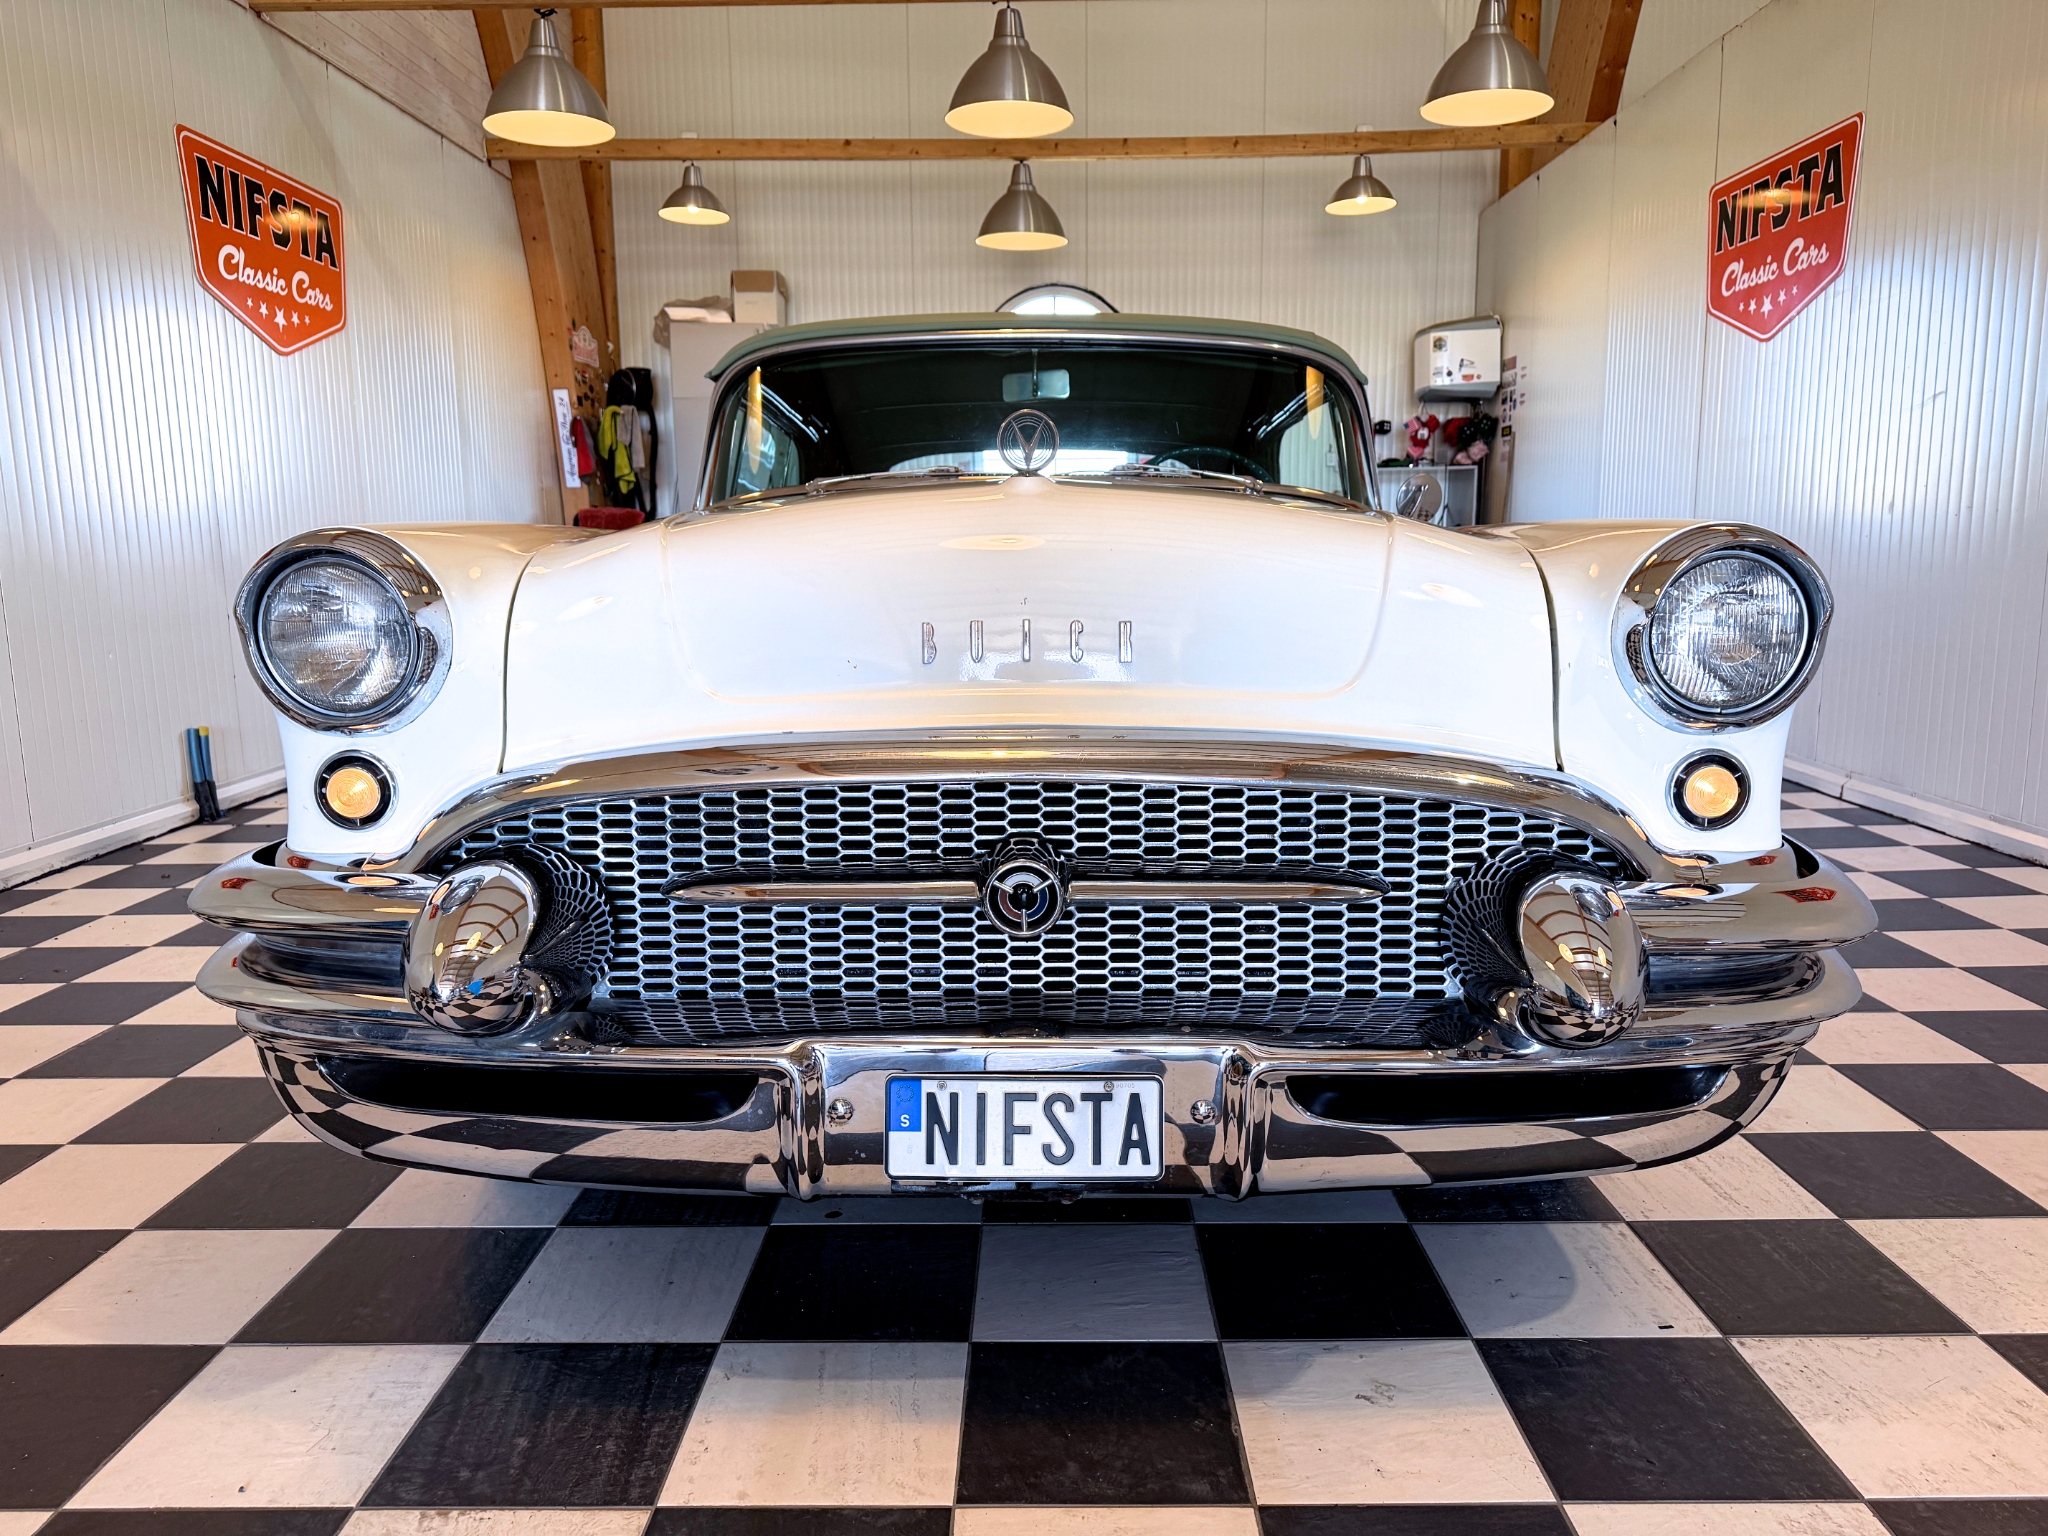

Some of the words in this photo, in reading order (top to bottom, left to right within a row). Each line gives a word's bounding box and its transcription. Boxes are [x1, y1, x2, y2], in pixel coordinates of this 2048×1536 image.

[193, 151, 340, 272] NIFSTA
[1714, 140, 1846, 256] NIFSTA
[217, 243, 288, 296] Classic
[291, 270, 333, 312] Cars
[1721, 255, 1779, 297] Classic
[1783, 236, 1830, 277] Cars
[921, 618, 1133, 664] BUICK
[900, 1114, 910, 1128] S
[925, 1091, 1151, 1166] NIFSTA
